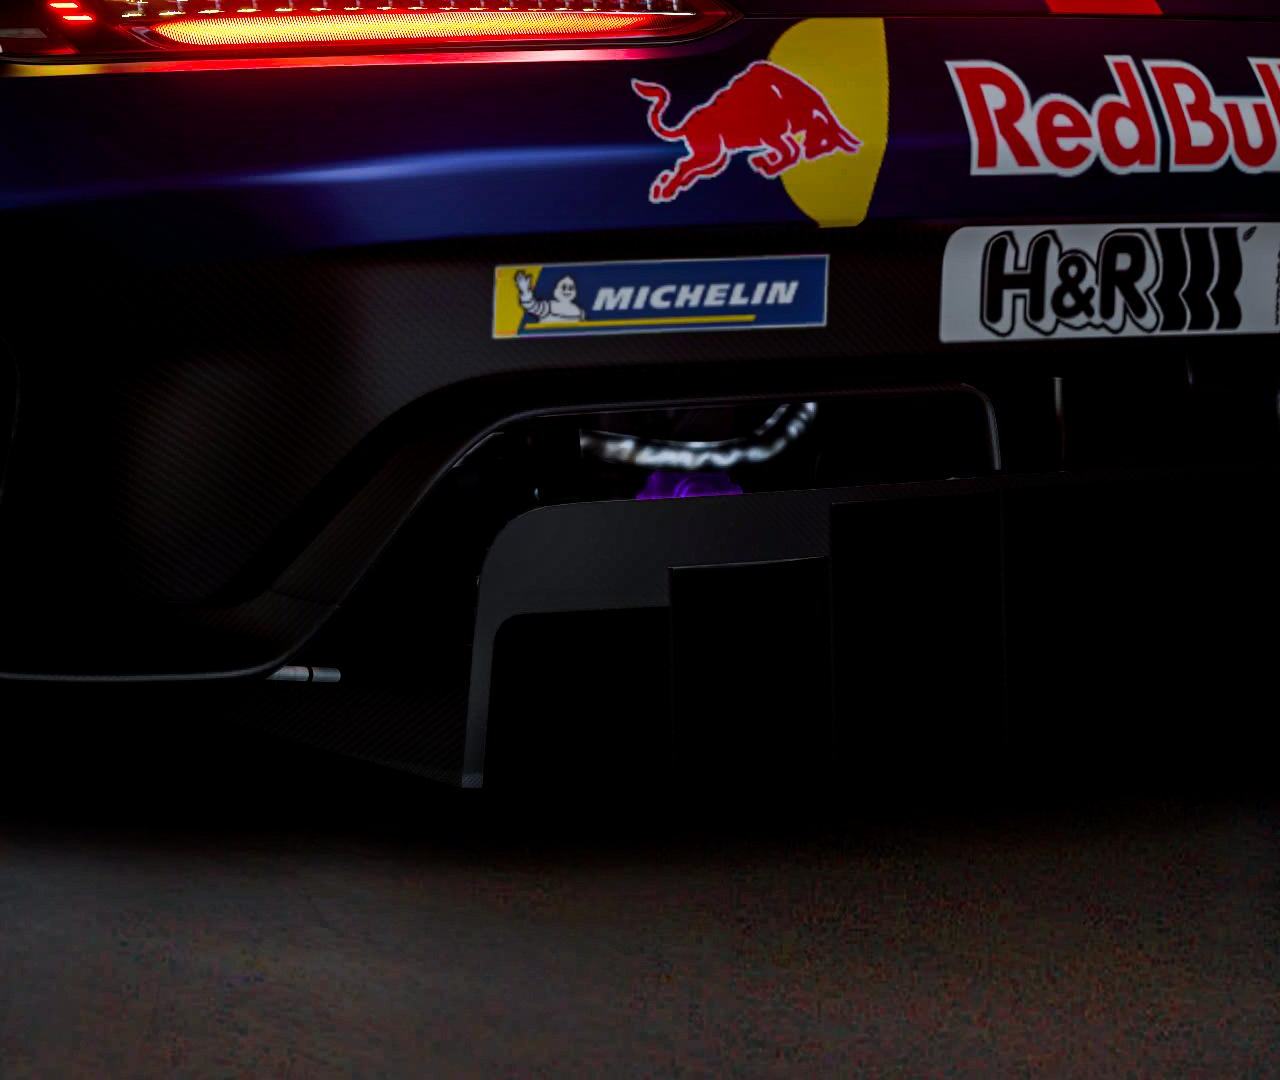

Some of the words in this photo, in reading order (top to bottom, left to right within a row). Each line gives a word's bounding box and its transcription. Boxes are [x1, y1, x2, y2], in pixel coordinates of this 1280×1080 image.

[945, 54, 1161, 177] Red
[592, 280, 800, 311] MICHELIN
[980, 228, 1161, 338] H&R
